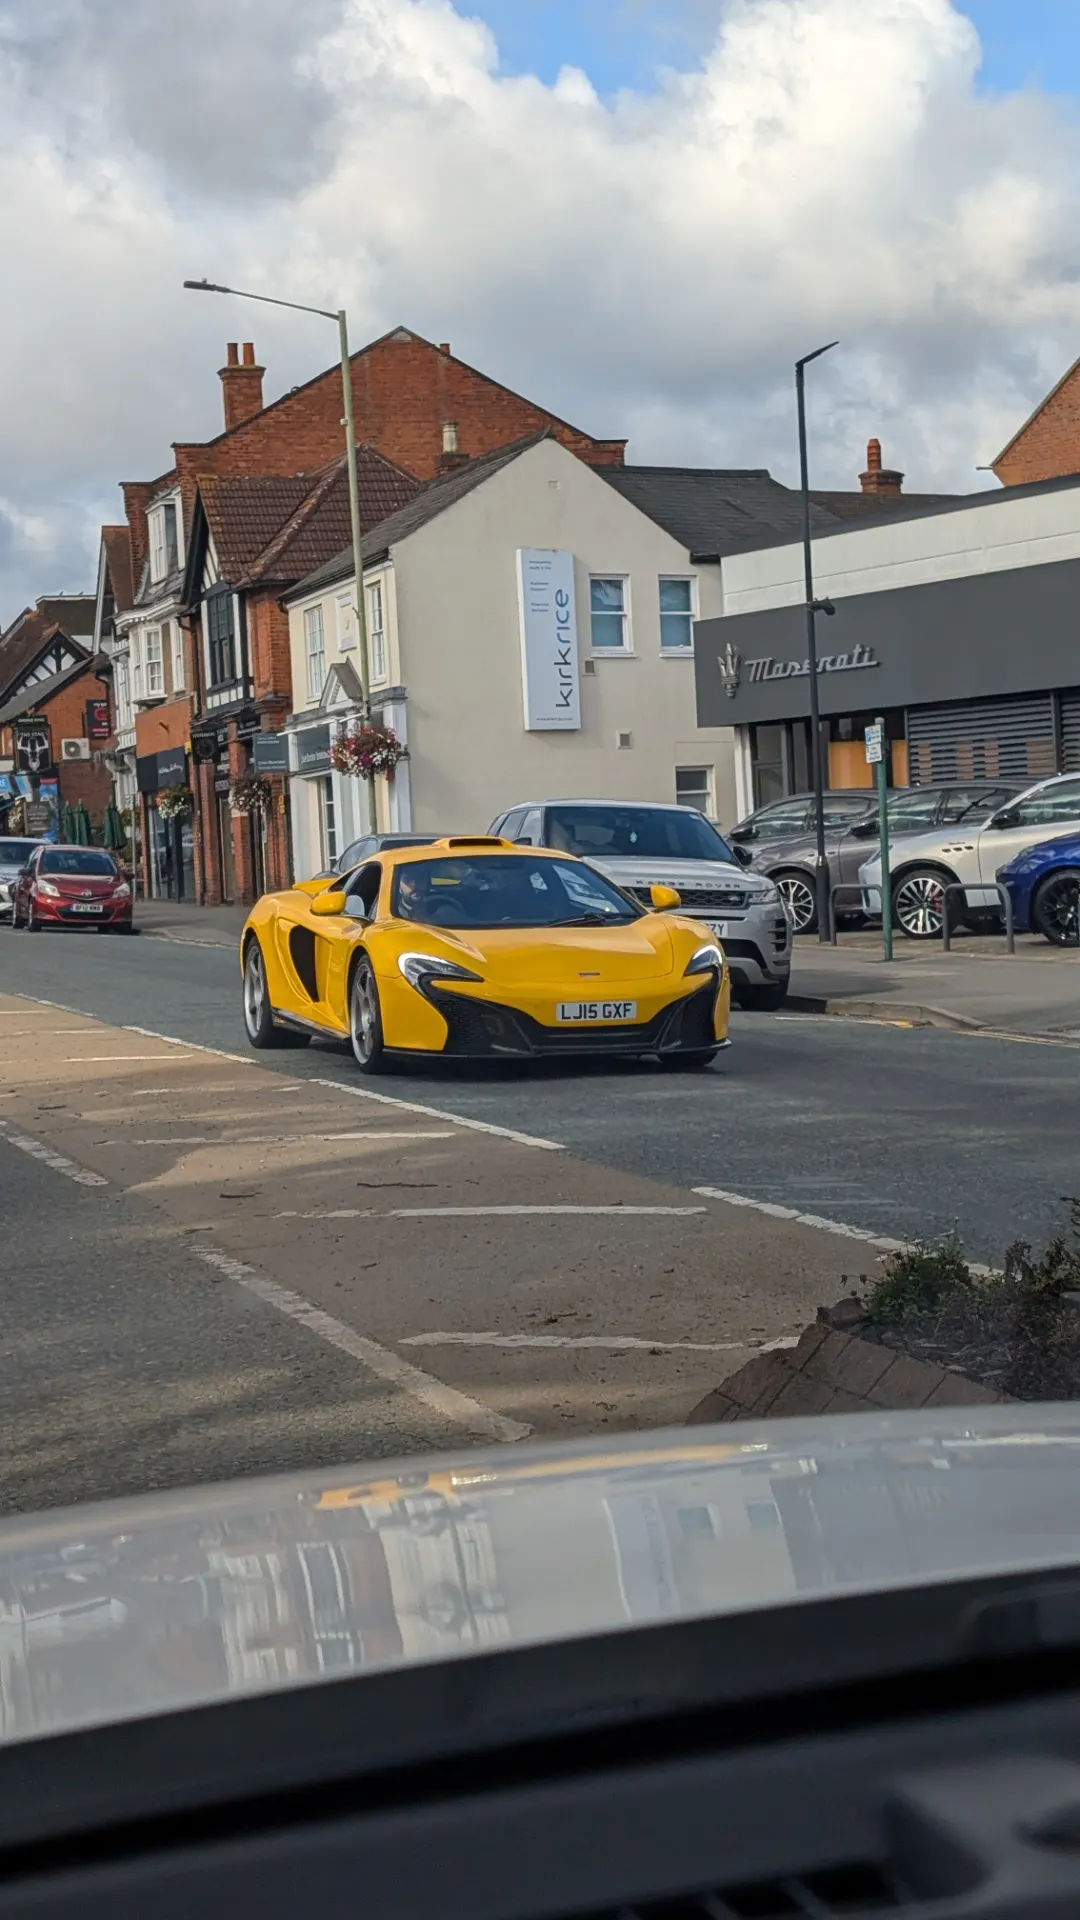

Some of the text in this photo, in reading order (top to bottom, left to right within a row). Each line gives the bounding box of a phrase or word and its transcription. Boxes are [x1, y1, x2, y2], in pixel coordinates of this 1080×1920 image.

[554, 589, 573, 707] kirkrice
[744, 643, 878, 681] Maserati
[561, 1002, 633, 1020] LJ15 GXF
